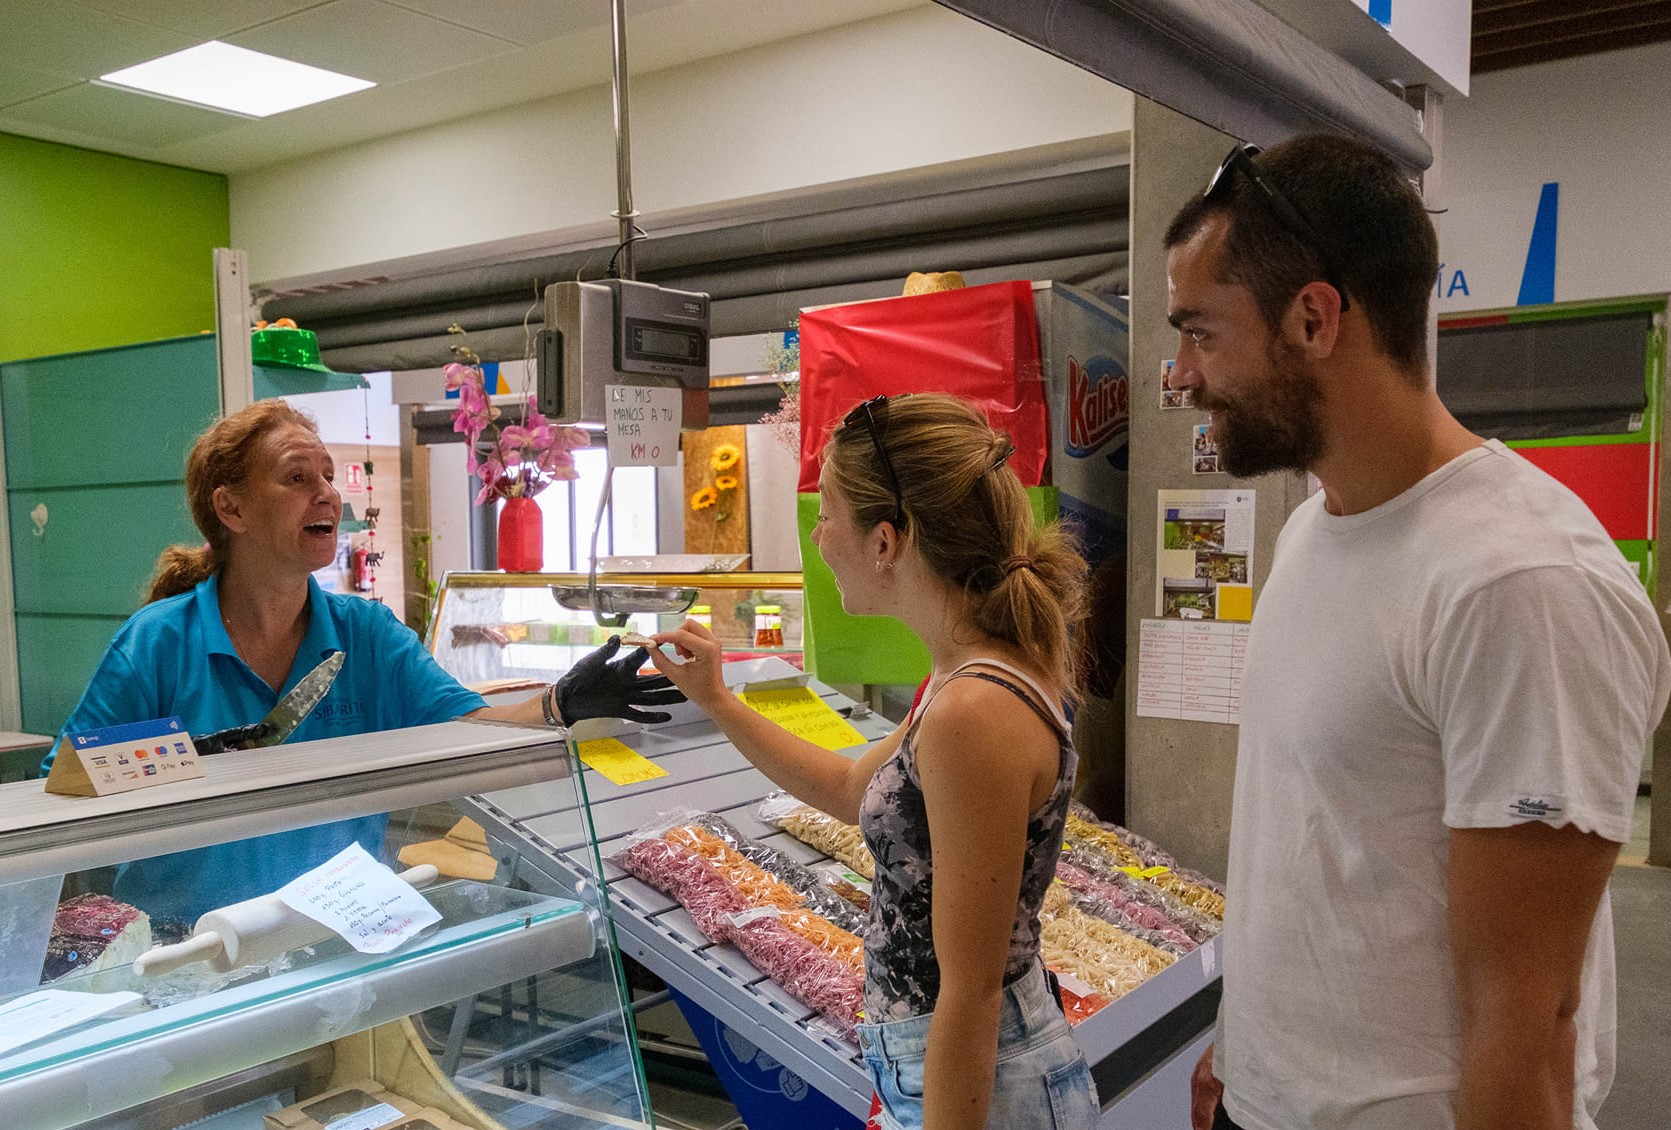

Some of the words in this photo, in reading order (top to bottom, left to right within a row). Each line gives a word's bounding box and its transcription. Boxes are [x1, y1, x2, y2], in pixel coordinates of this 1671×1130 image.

[1436, 263, 1469, 298] ÍA
[635, 389, 653, 403] MIS
[1066, 355, 1128, 449] Kalise
[613, 407, 645, 421] MANOS
[651, 407, 658, 421] A
[661, 407, 673, 421] TU
[617, 423, 641, 436] MESA
[630, 443, 646, 460] KM
